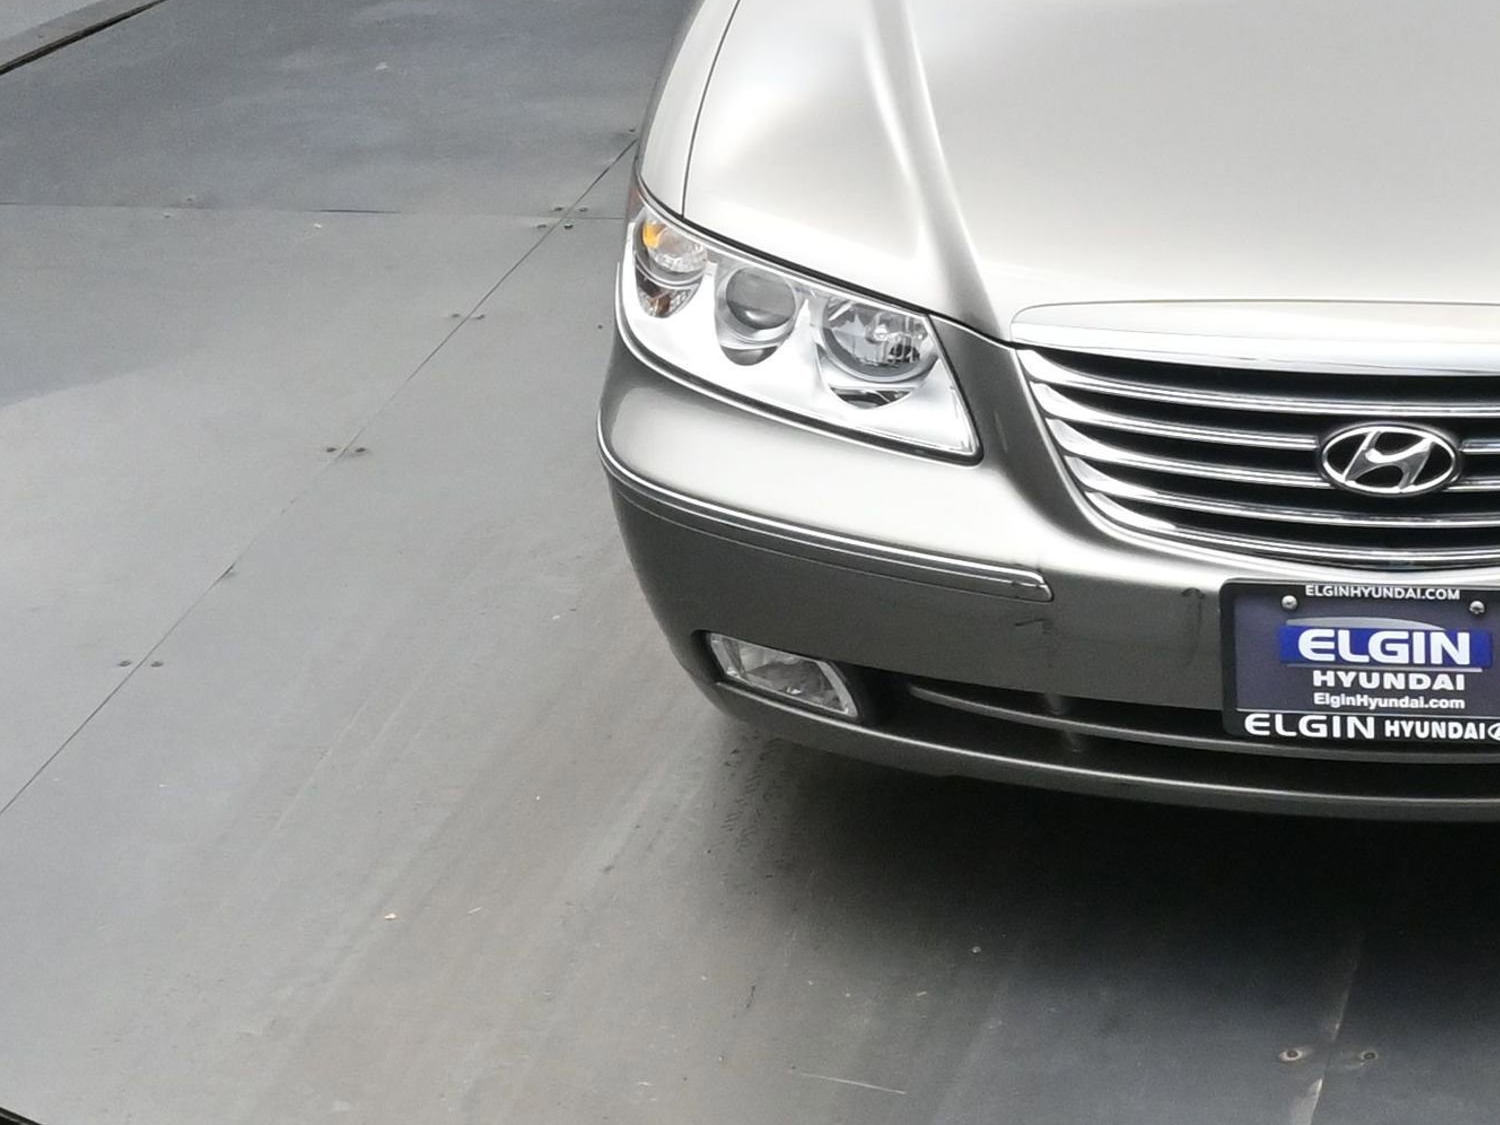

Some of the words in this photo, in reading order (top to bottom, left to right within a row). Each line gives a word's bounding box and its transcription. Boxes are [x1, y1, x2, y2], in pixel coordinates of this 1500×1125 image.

[1304, 584, 1461, 601] ELGINHYUNDAI.COM
[1298, 628, 1471, 666] ELGIN
[1312, 670, 1466, 691] HYUNDAI
[1313, 691, 1466, 710] ElginHyundai.com
[1244, 712, 1376, 740] ELGIN
[1384, 719, 1486, 741] HYUNDAI
